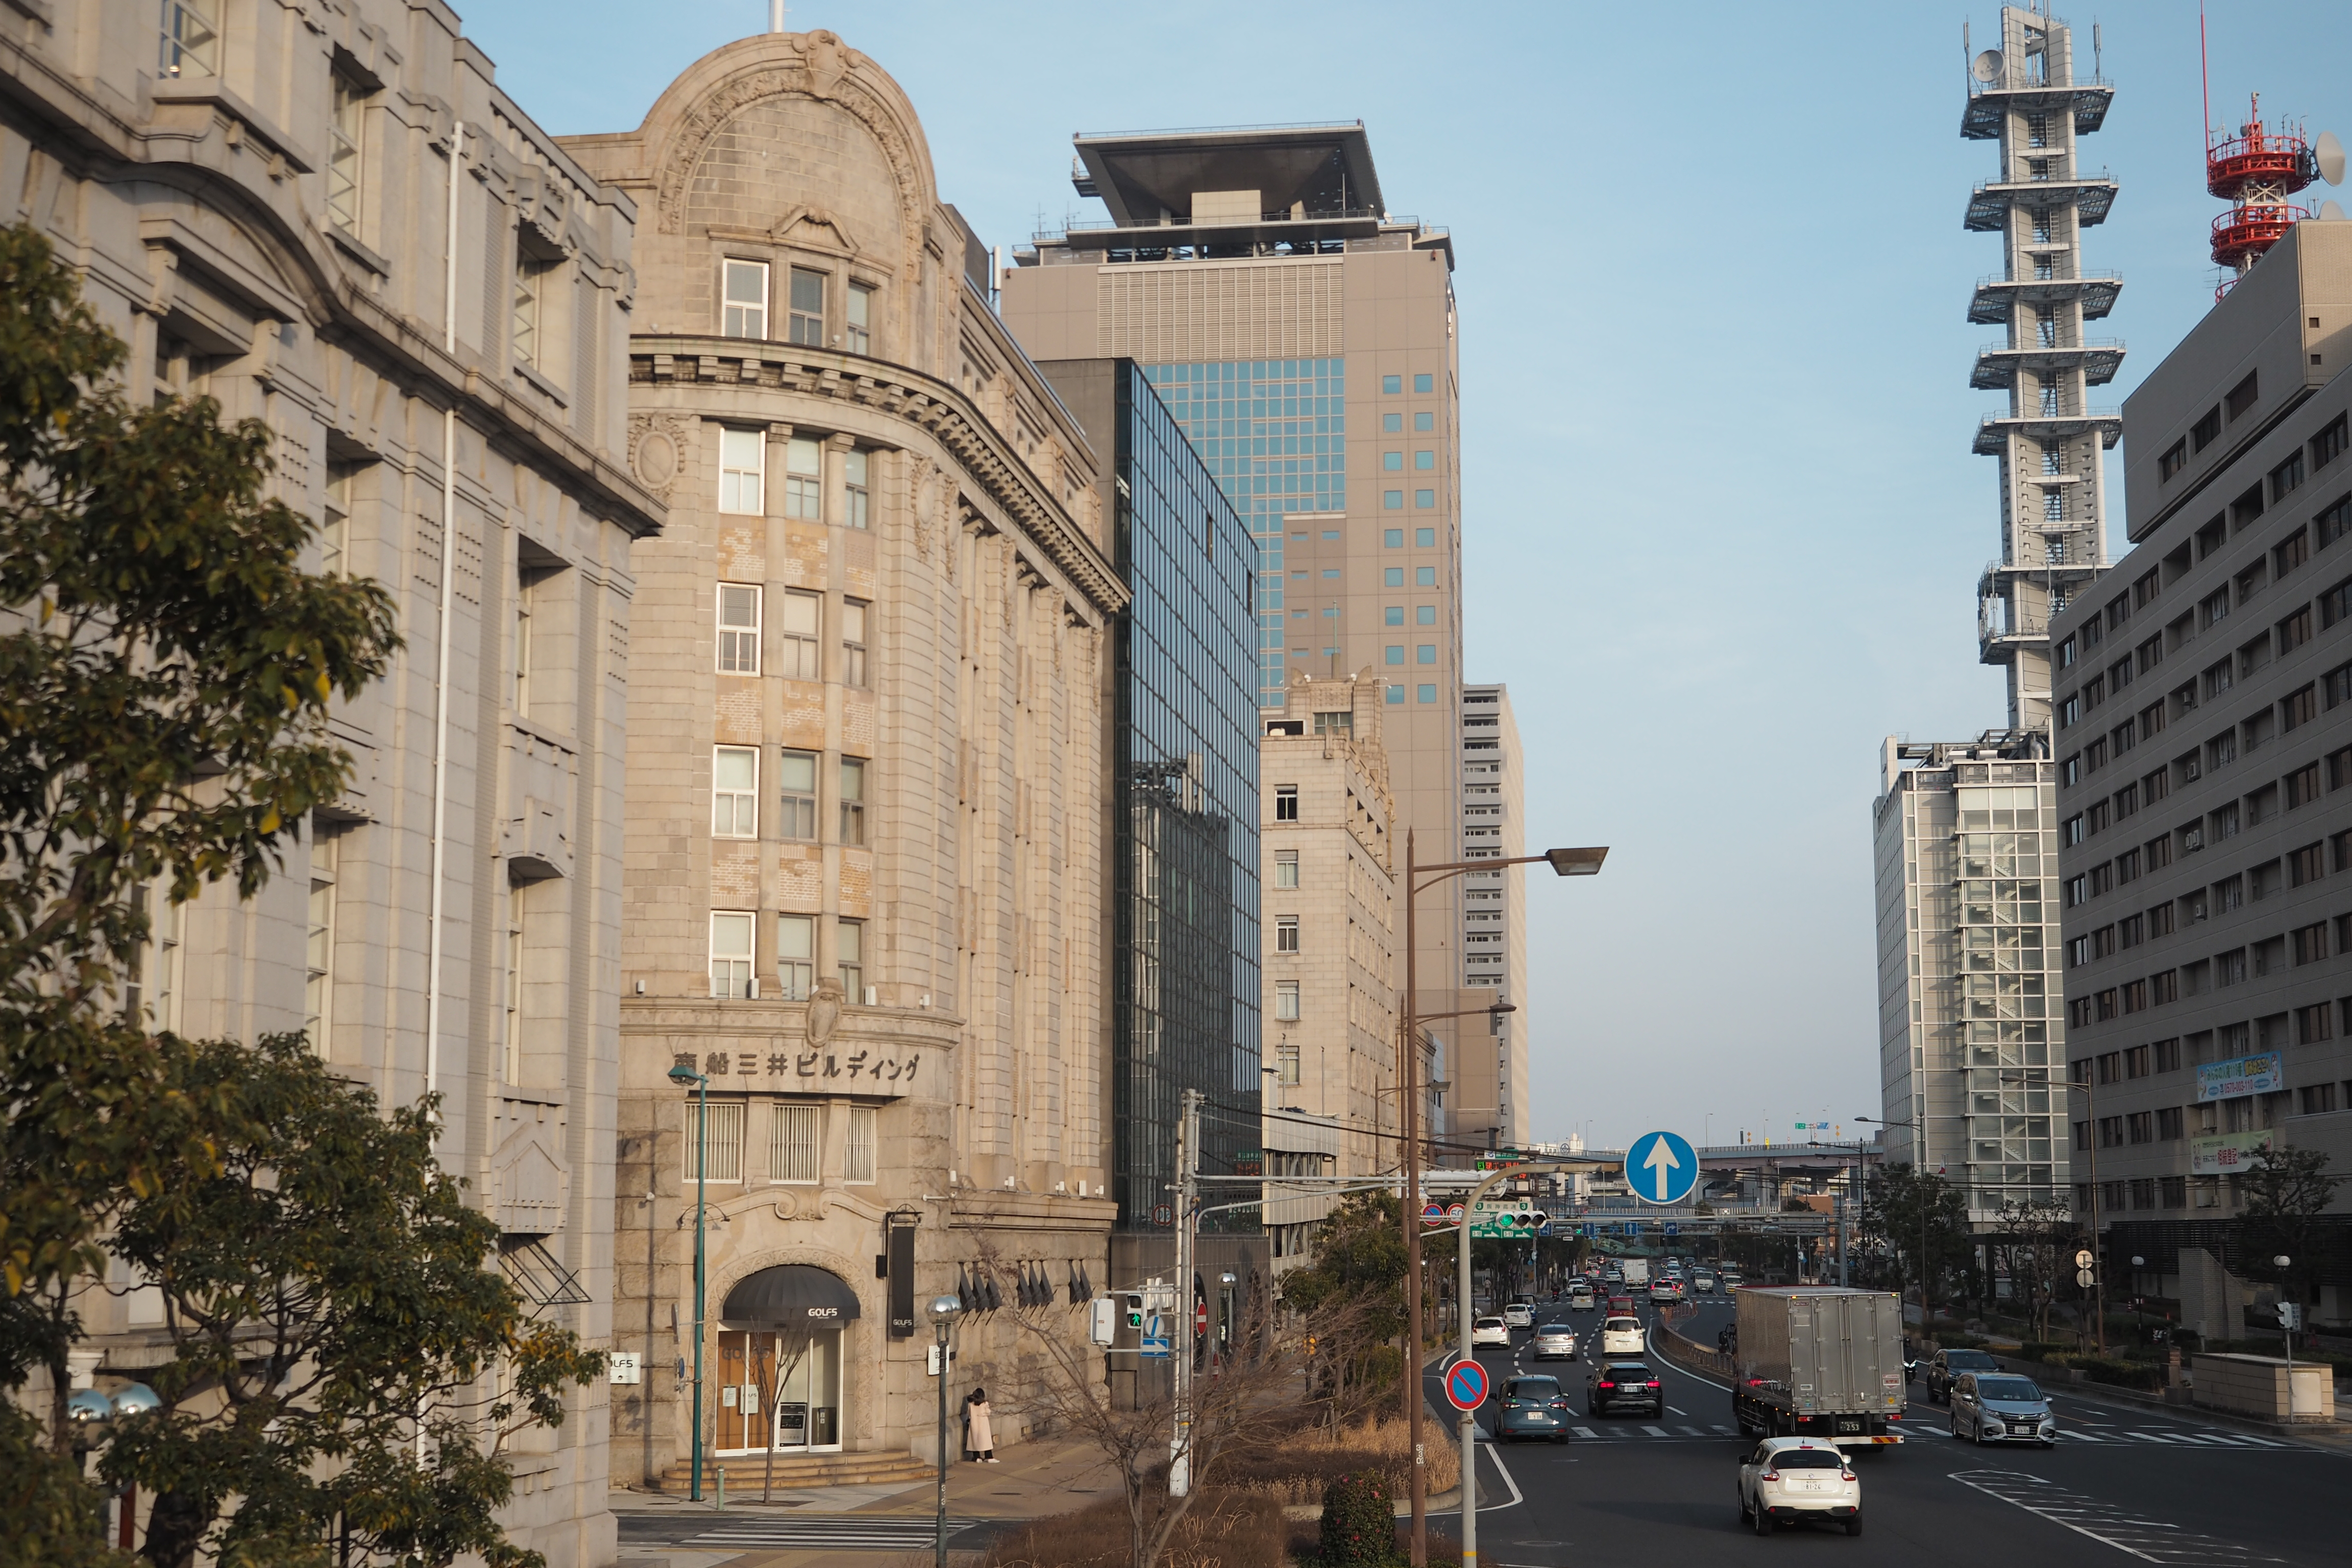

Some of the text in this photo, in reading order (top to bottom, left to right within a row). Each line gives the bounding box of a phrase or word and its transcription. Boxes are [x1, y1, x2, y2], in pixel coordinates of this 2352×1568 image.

[674, 1049, 920, 1082] 商船三井ビルディング
[2224, 1079, 2252, 1093] 0570-003-110
[1451, 1210, 1463, 1219] 50
[808, 1308, 838, 1317] GOLF5
[610, 1360, 633, 1368] LF5
